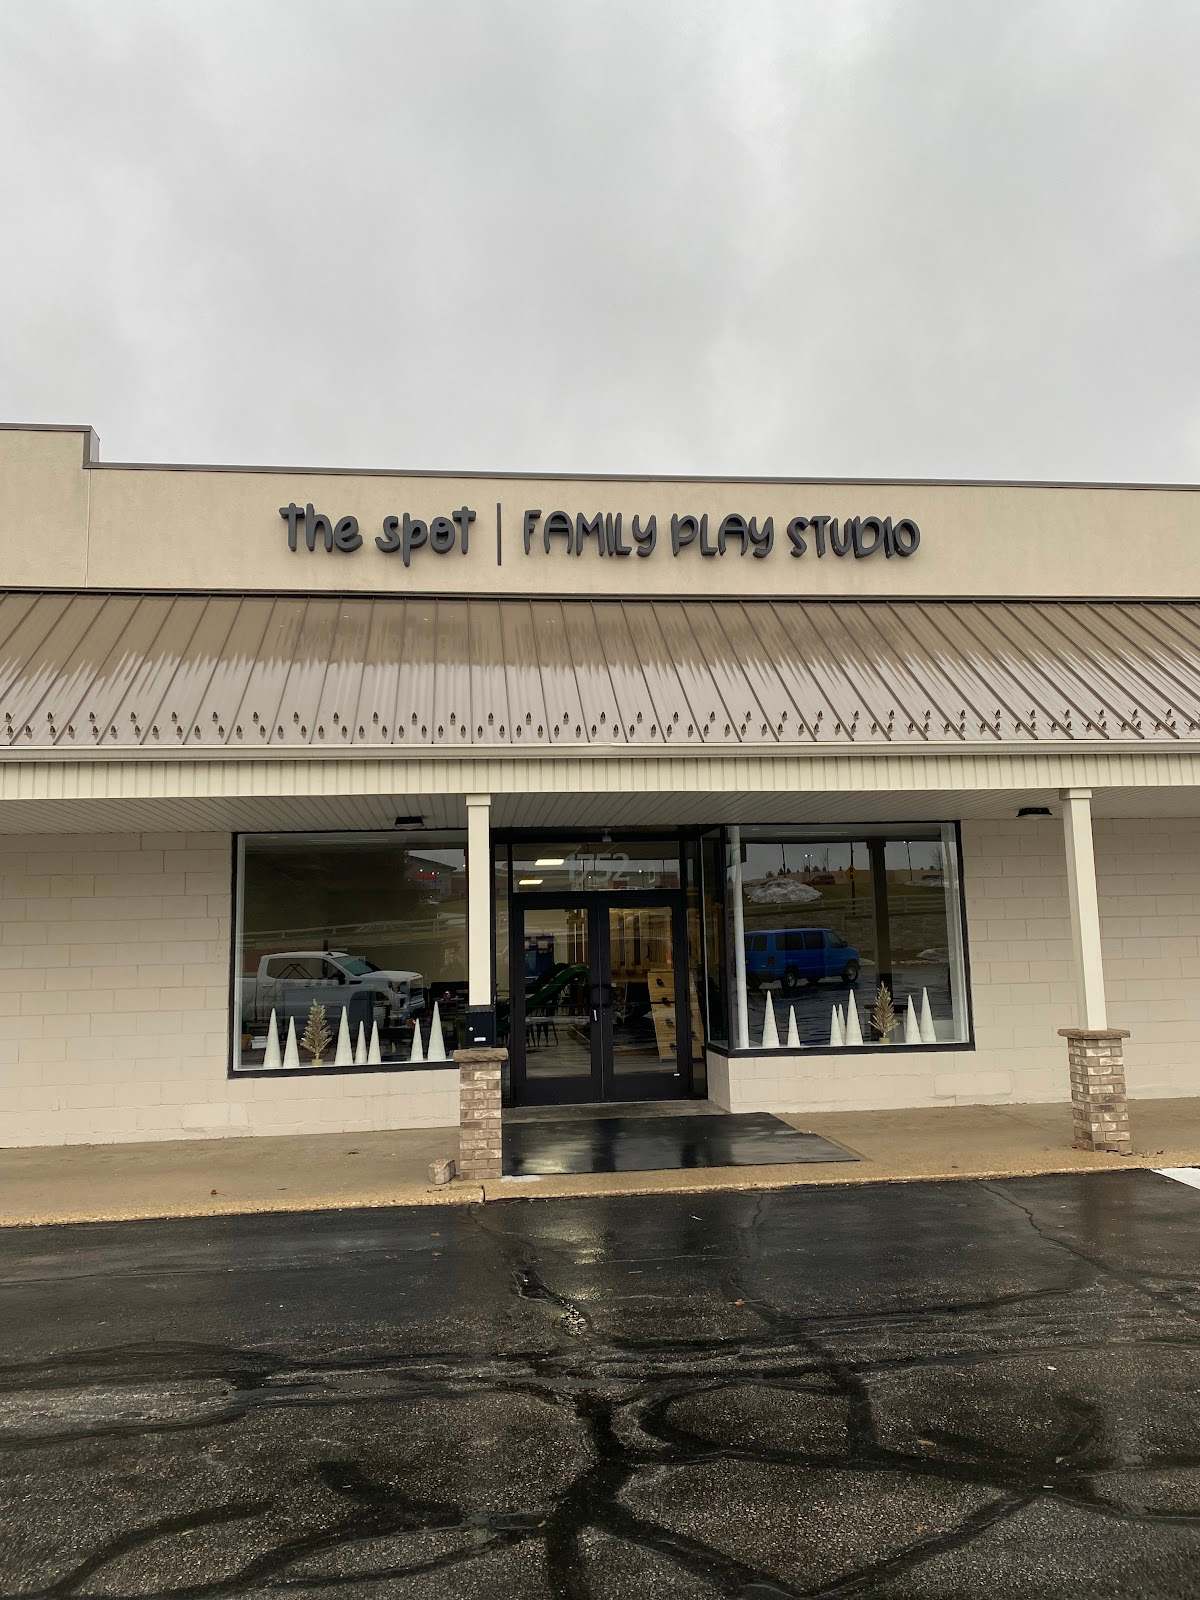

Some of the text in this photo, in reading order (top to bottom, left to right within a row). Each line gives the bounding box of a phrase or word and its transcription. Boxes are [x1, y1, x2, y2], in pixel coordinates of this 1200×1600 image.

[279, 503, 921, 568] the spot FAMILY PLAY STUDIO
